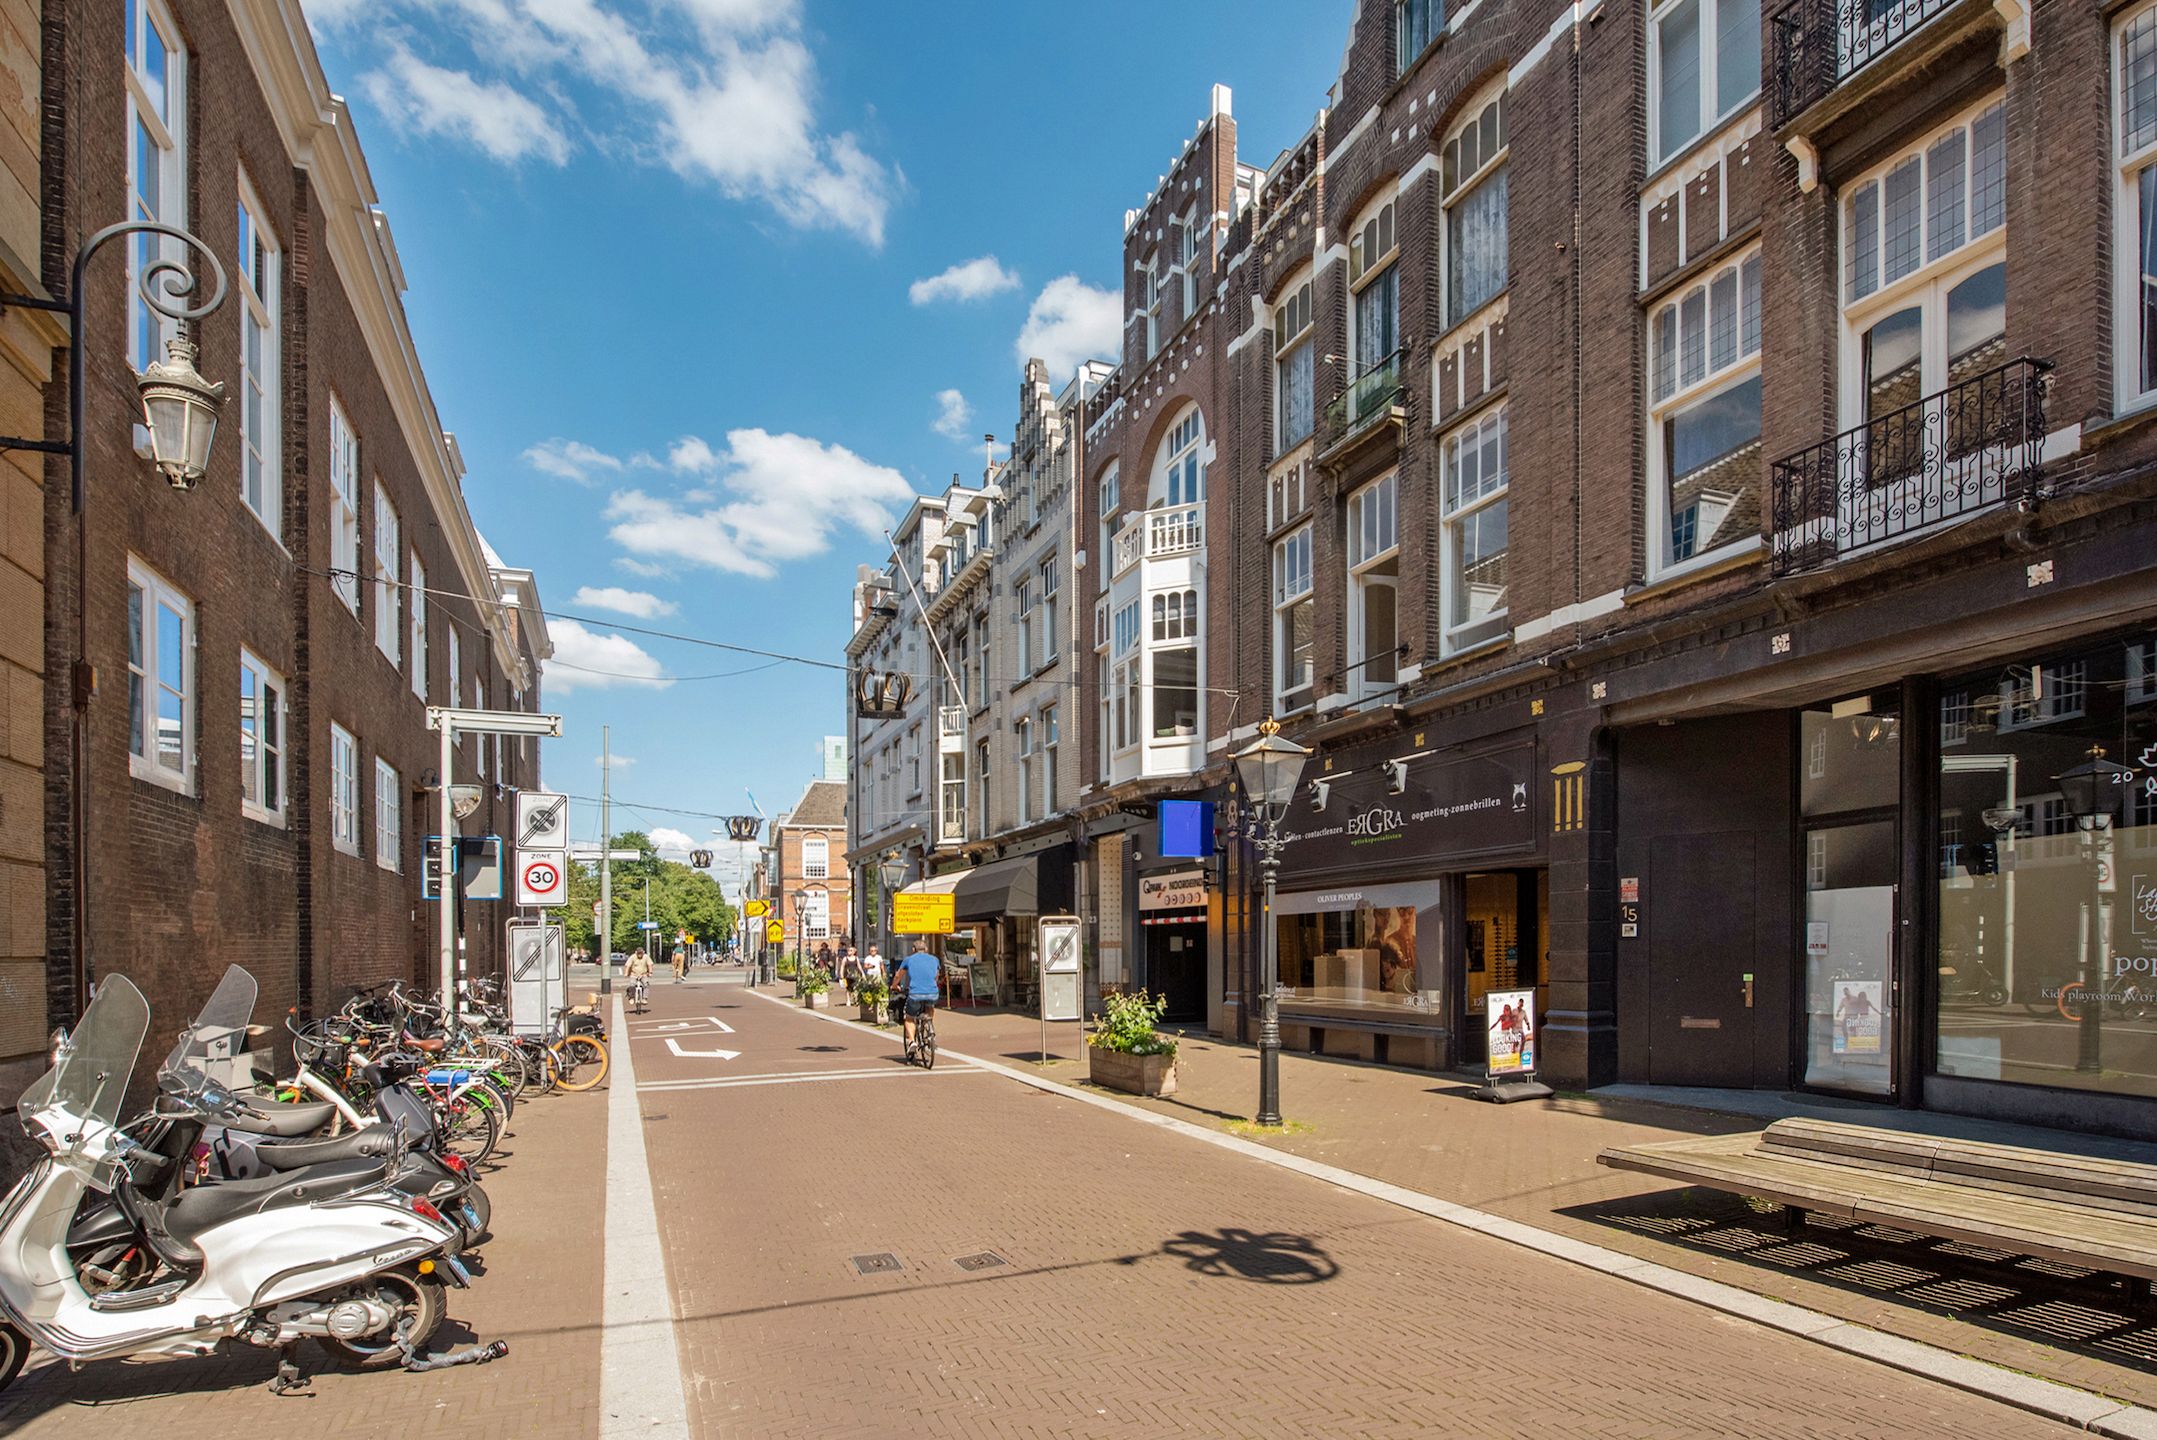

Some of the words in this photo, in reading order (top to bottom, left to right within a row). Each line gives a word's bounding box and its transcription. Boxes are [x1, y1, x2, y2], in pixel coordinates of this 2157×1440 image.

[2112, 771, 2134, 784] 20
[530, 871, 554, 884] 30
[1317, 894, 1337, 903] OLIVER
[1338, 892, 1362, 901] PEOPLES
[1622, 905, 1638, 921] 15
[2041, 988, 2065, 999] Kids
[2068, 989, 2120, 1003] playroom
[2123, 990, 2157, 1001] Wor
[1492, 1032, 1522, 1044] LOOKING
